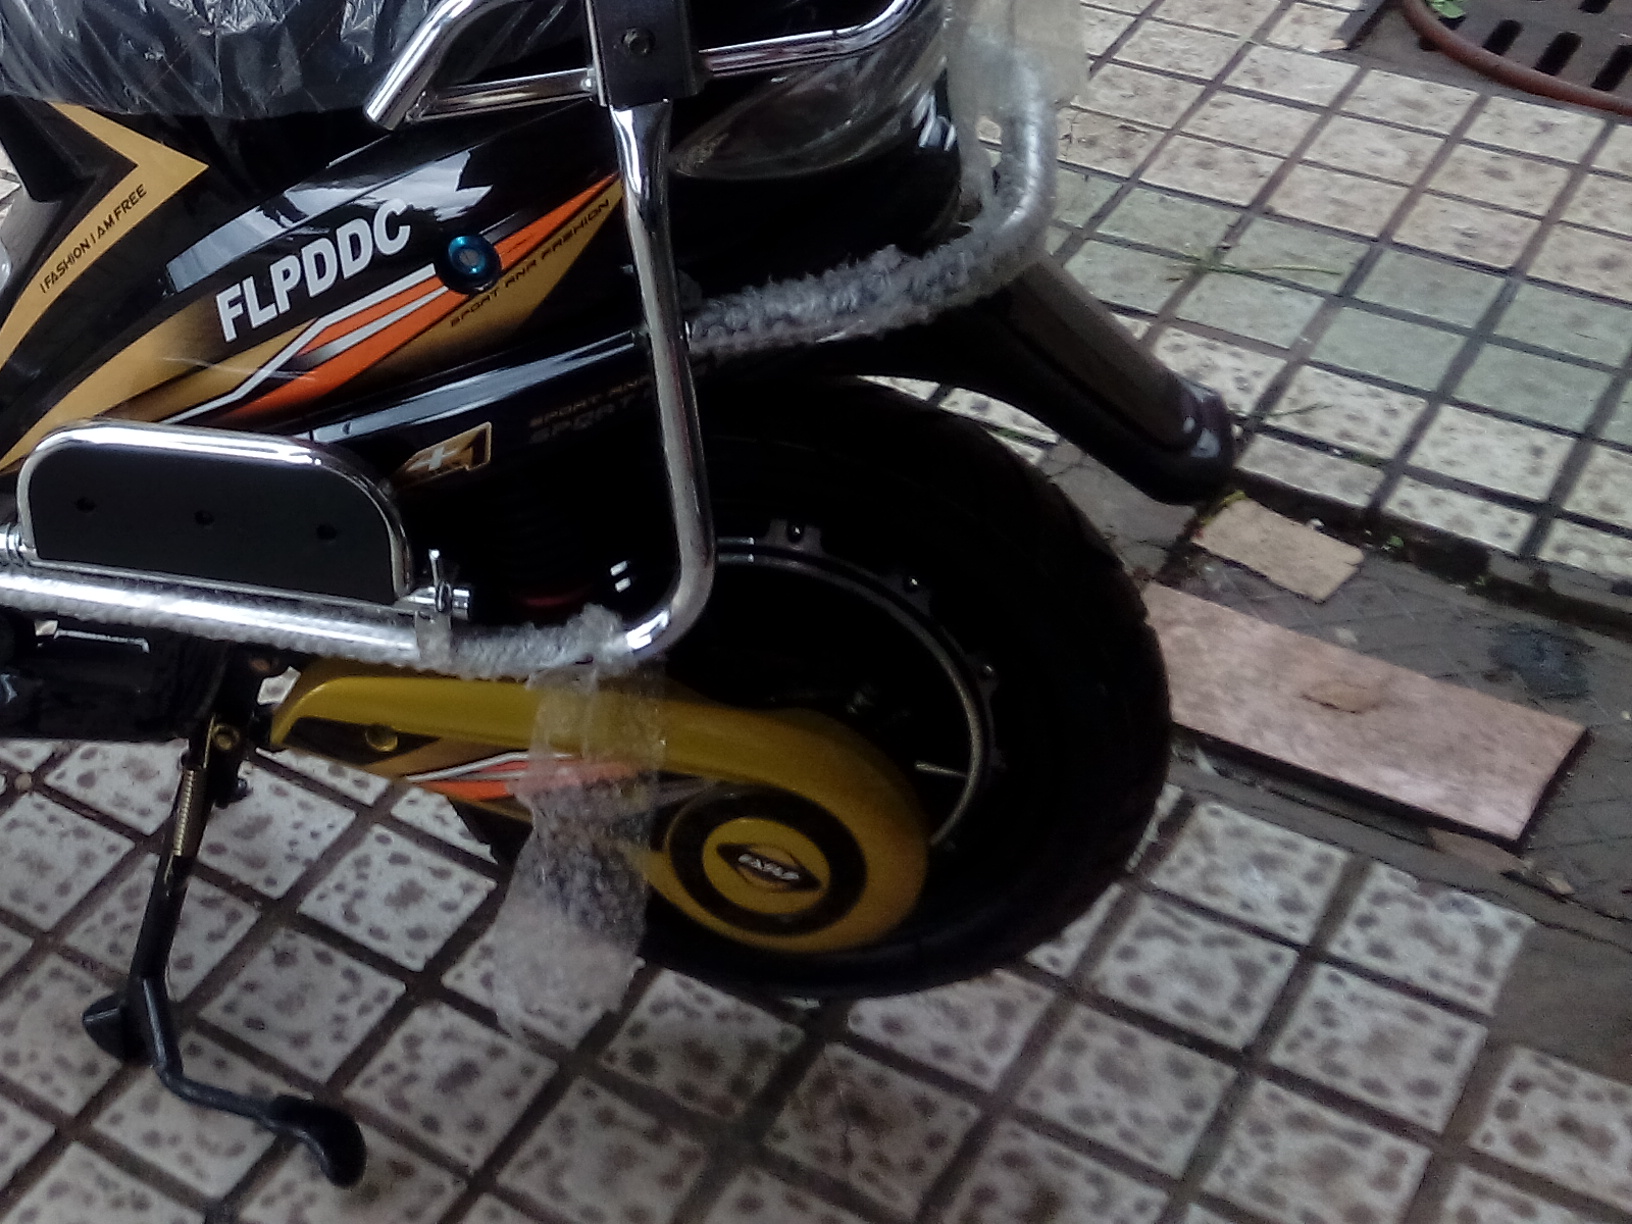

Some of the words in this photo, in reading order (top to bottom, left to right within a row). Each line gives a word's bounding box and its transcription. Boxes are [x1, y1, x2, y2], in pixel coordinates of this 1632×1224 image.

[43, 238, 91, 289] FASHION
[113, 183, 147, 221] FREE
[216, 198, 411, 343] FLPDDC
